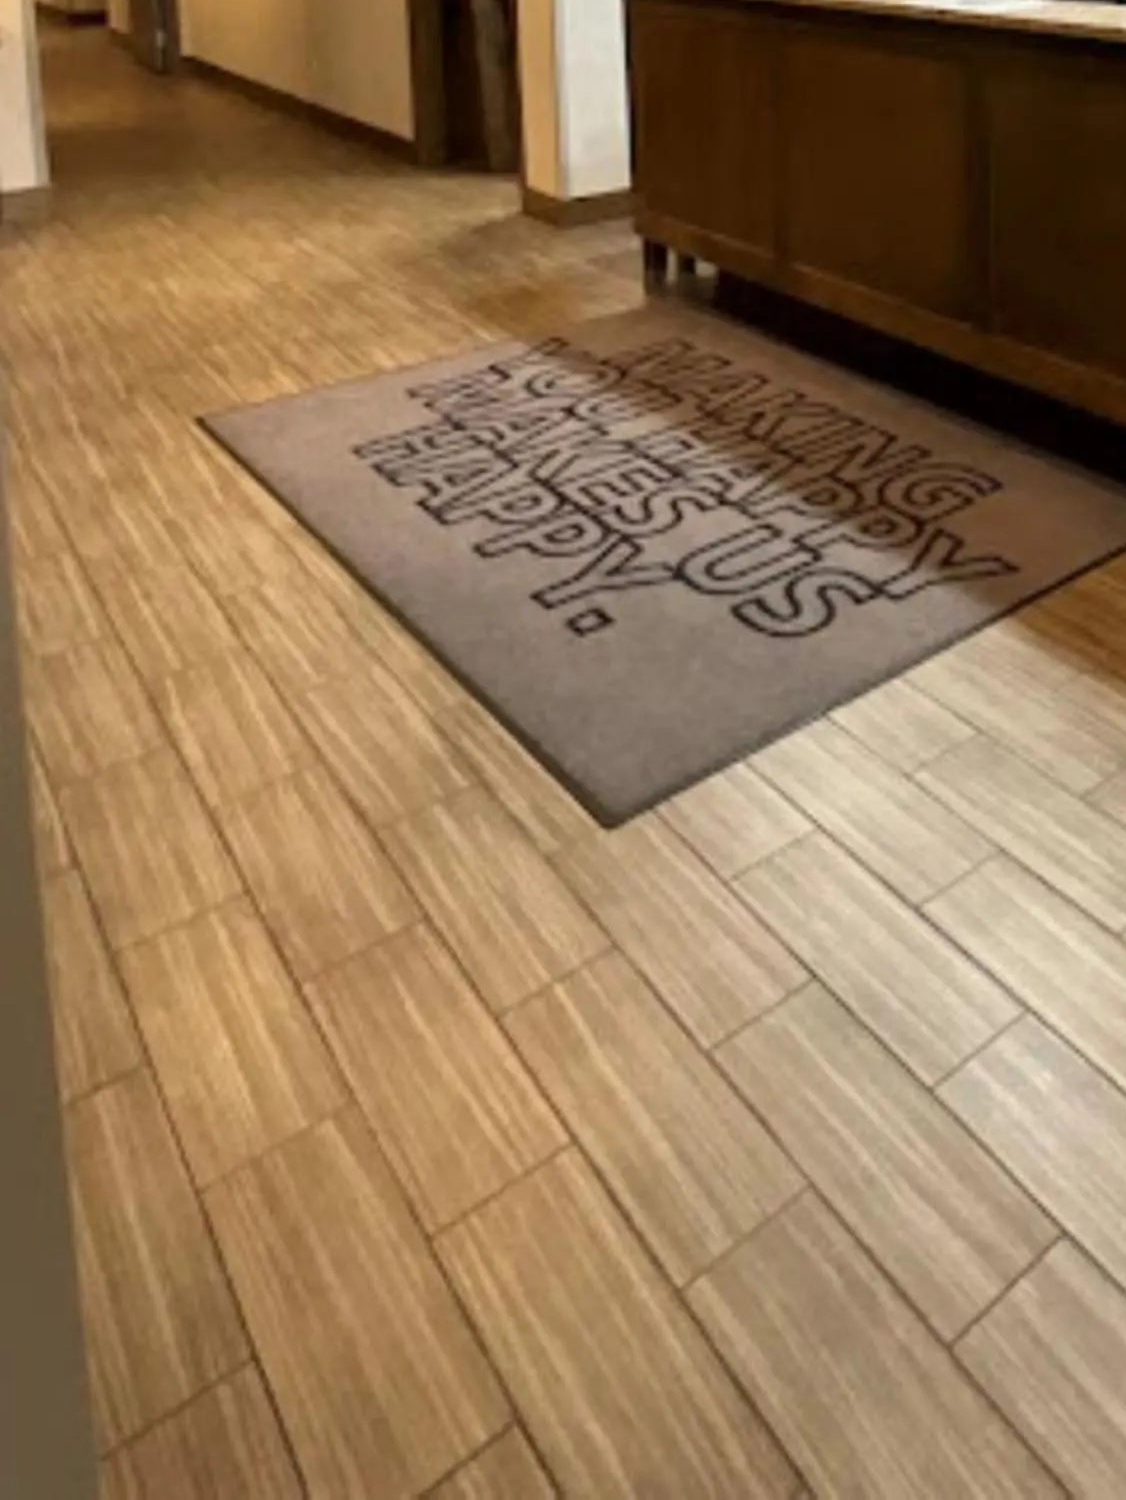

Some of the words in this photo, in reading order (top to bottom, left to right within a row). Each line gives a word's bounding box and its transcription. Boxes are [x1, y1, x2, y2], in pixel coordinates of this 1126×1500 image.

[351, 419, 680, 637] HAPPY.
[403, 366, 726, 540] MAKES
[676, 522, 874, 638] US
[613, 338, 1003, 525] MAKING
[623, 417, 1020, 601] HAPPY
